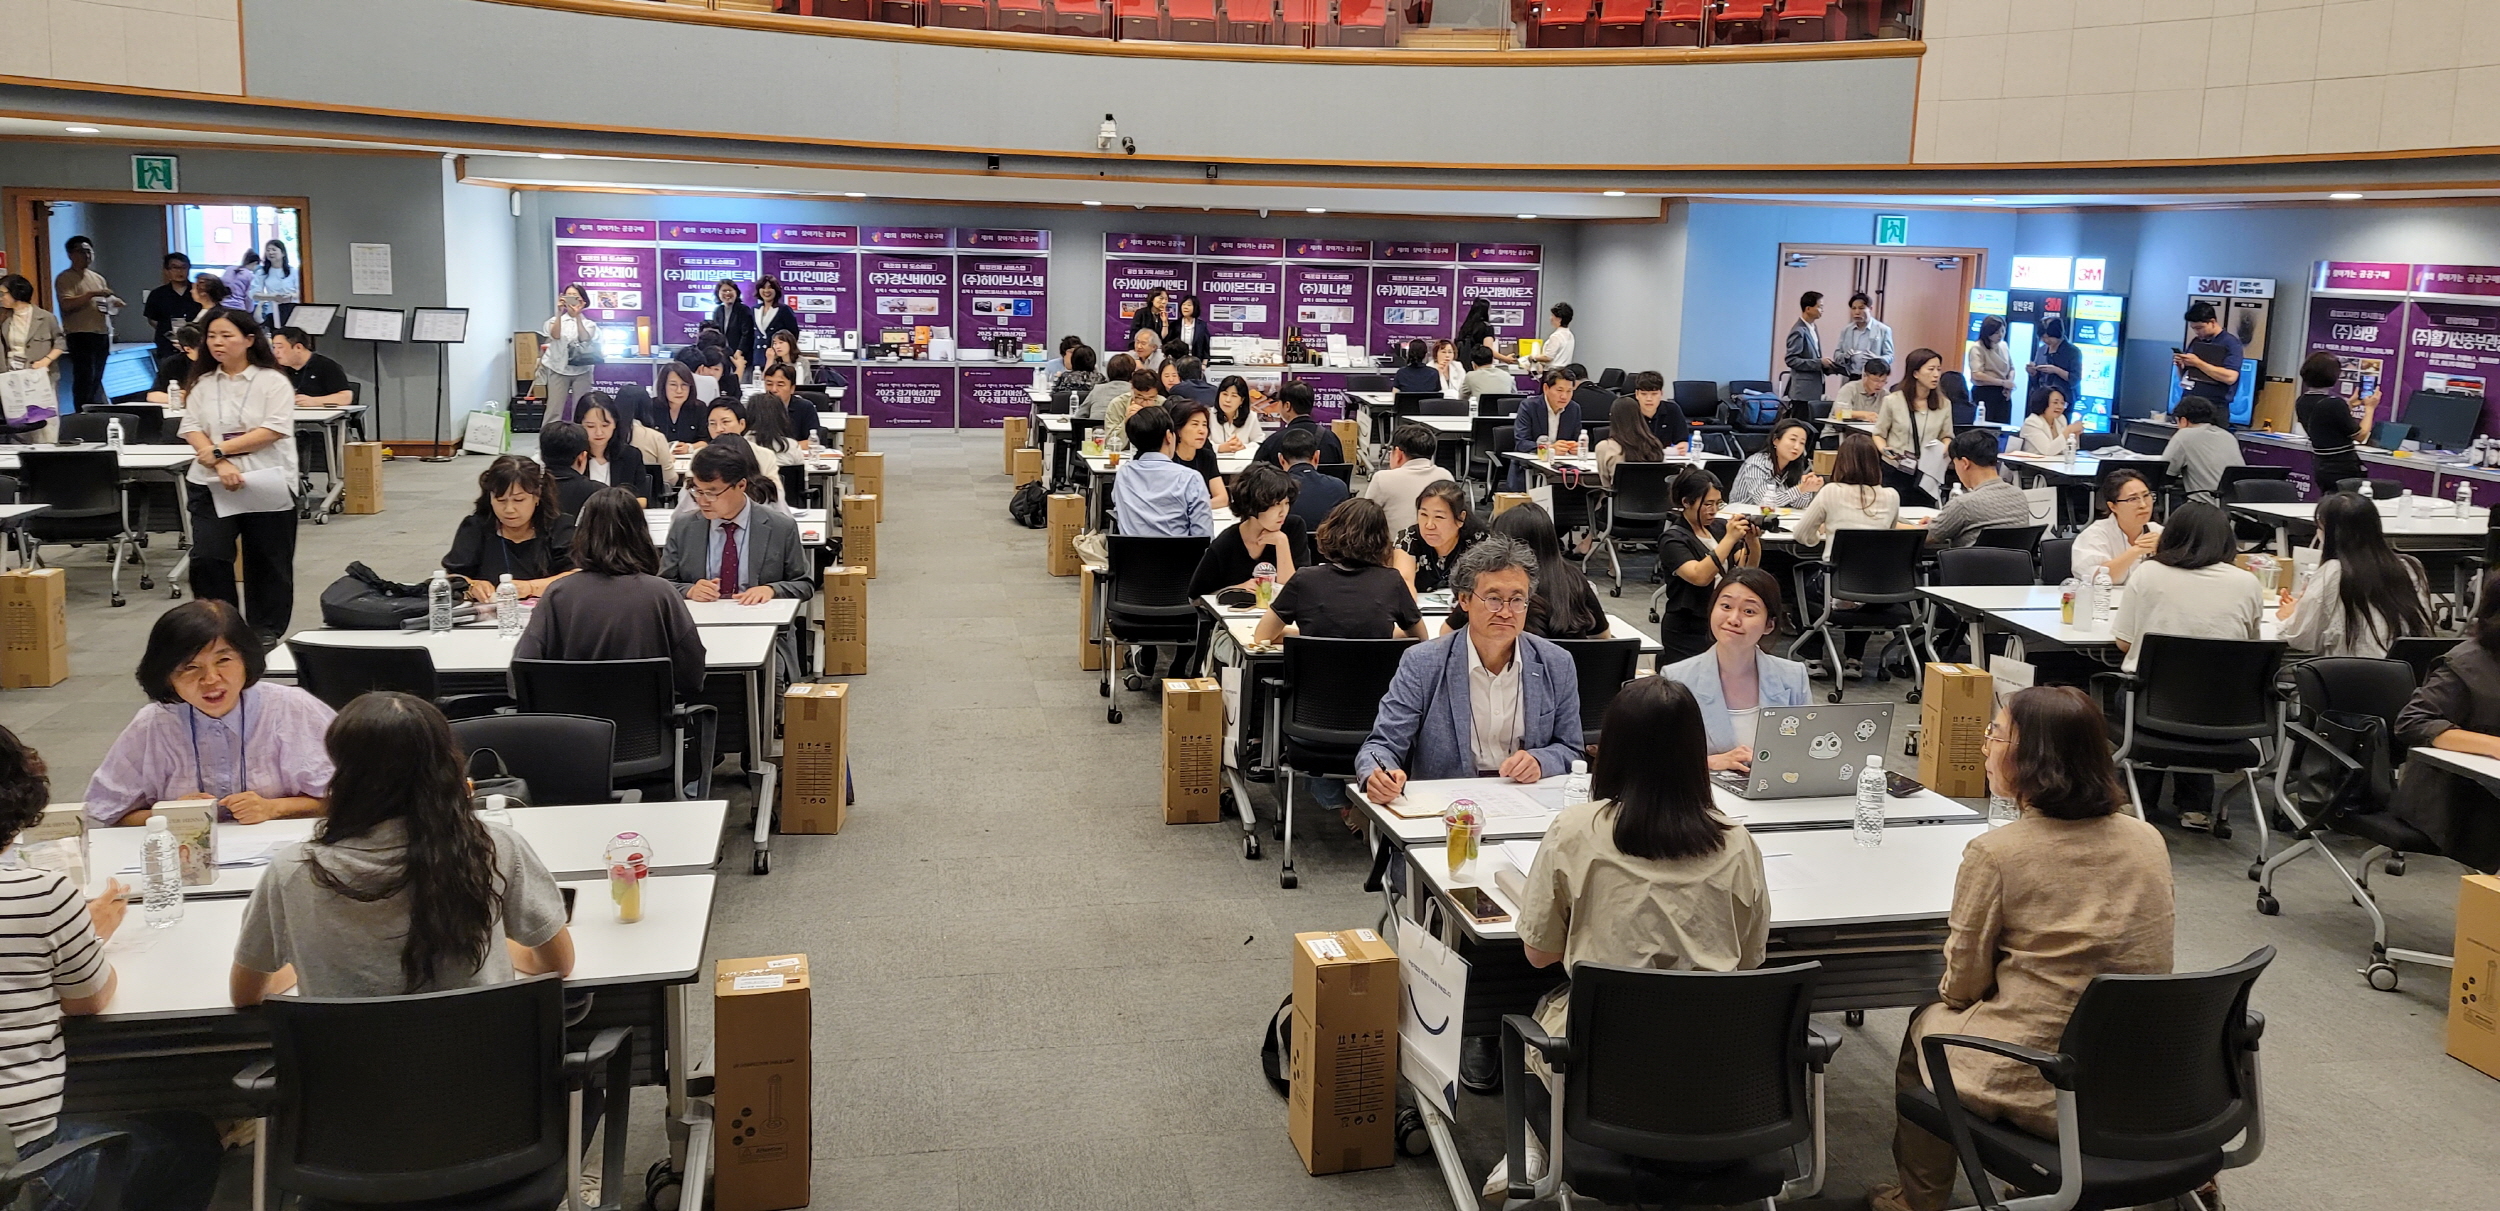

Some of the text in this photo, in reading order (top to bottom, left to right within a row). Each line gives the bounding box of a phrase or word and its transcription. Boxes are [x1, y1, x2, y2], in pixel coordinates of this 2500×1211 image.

[780, 271, 840, 284] 디자인미창
[869, 272, 947, 285] (주)경신바이오
[962, 274, 1044, 287] (주)하이브시스템
[2078, 268, 2102, 281] 3M
[2359, 269, 2390, 280] 공공구매
[1203, 281, 1276, 294] 다이아몬드테크
[1299, 283, 1353, 295] (주)제나셀
[1376, 285, 1447, 297] (주)케이글라스텍
[1462, 286, 1534, 298] (주)쓰리엠아토즈
[2198, 279, 2232, 294] SAVE
[2045, 297, 2062, 311] 3M
[2332, 323, 2379, 342] (주)희망
